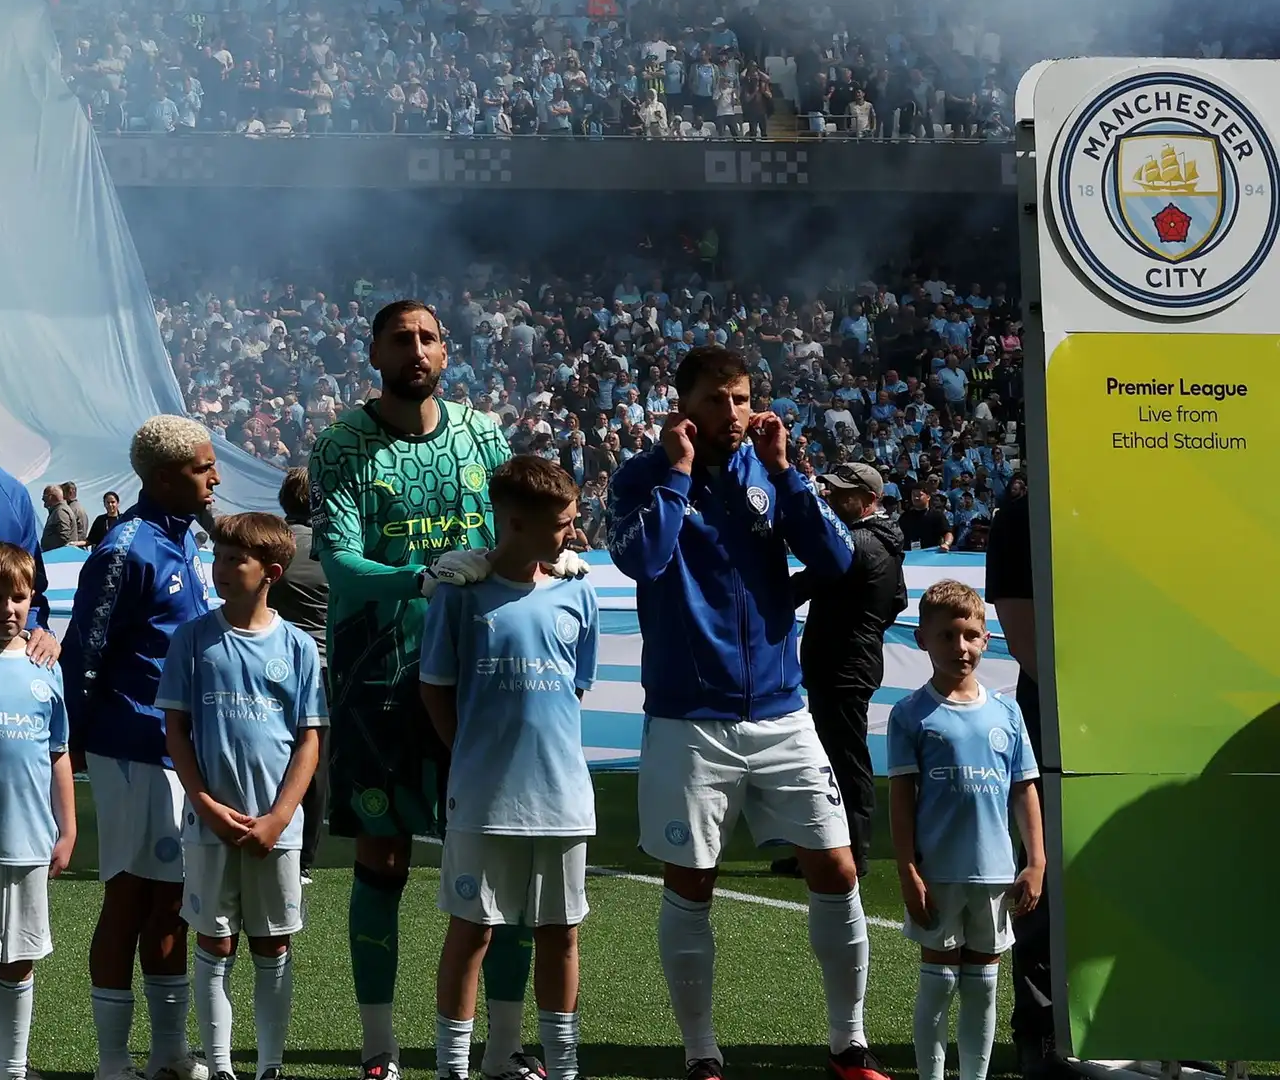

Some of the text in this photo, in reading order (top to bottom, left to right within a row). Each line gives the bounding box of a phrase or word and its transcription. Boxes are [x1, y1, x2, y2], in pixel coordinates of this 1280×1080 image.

[1082, 91, 1254, 162] MANCHESTER
[1078, 184, 1265, 197] 18 94
[1145, 267, 1208, 289] CITY
[1107, 378, 1248, 401] Premier League
[1139, 406, 1218, 422] Live from
[1113, 432, 1247, 450] Etihad Stadium
[382, 512, 484, 537] ETIHAD
[408, 534, 467, 551] AIRWAYS
[476, 657, 572, 677] ETIHAD
[498, 680, 561, 692] AIRWAYS
[202, 691, 283, 711] ETIHAD
[217, 709, 268, 722] AIRWAYS
[819, 767, 841, 806] 3
[950, 784, 1000, 795] AIRWAYS
